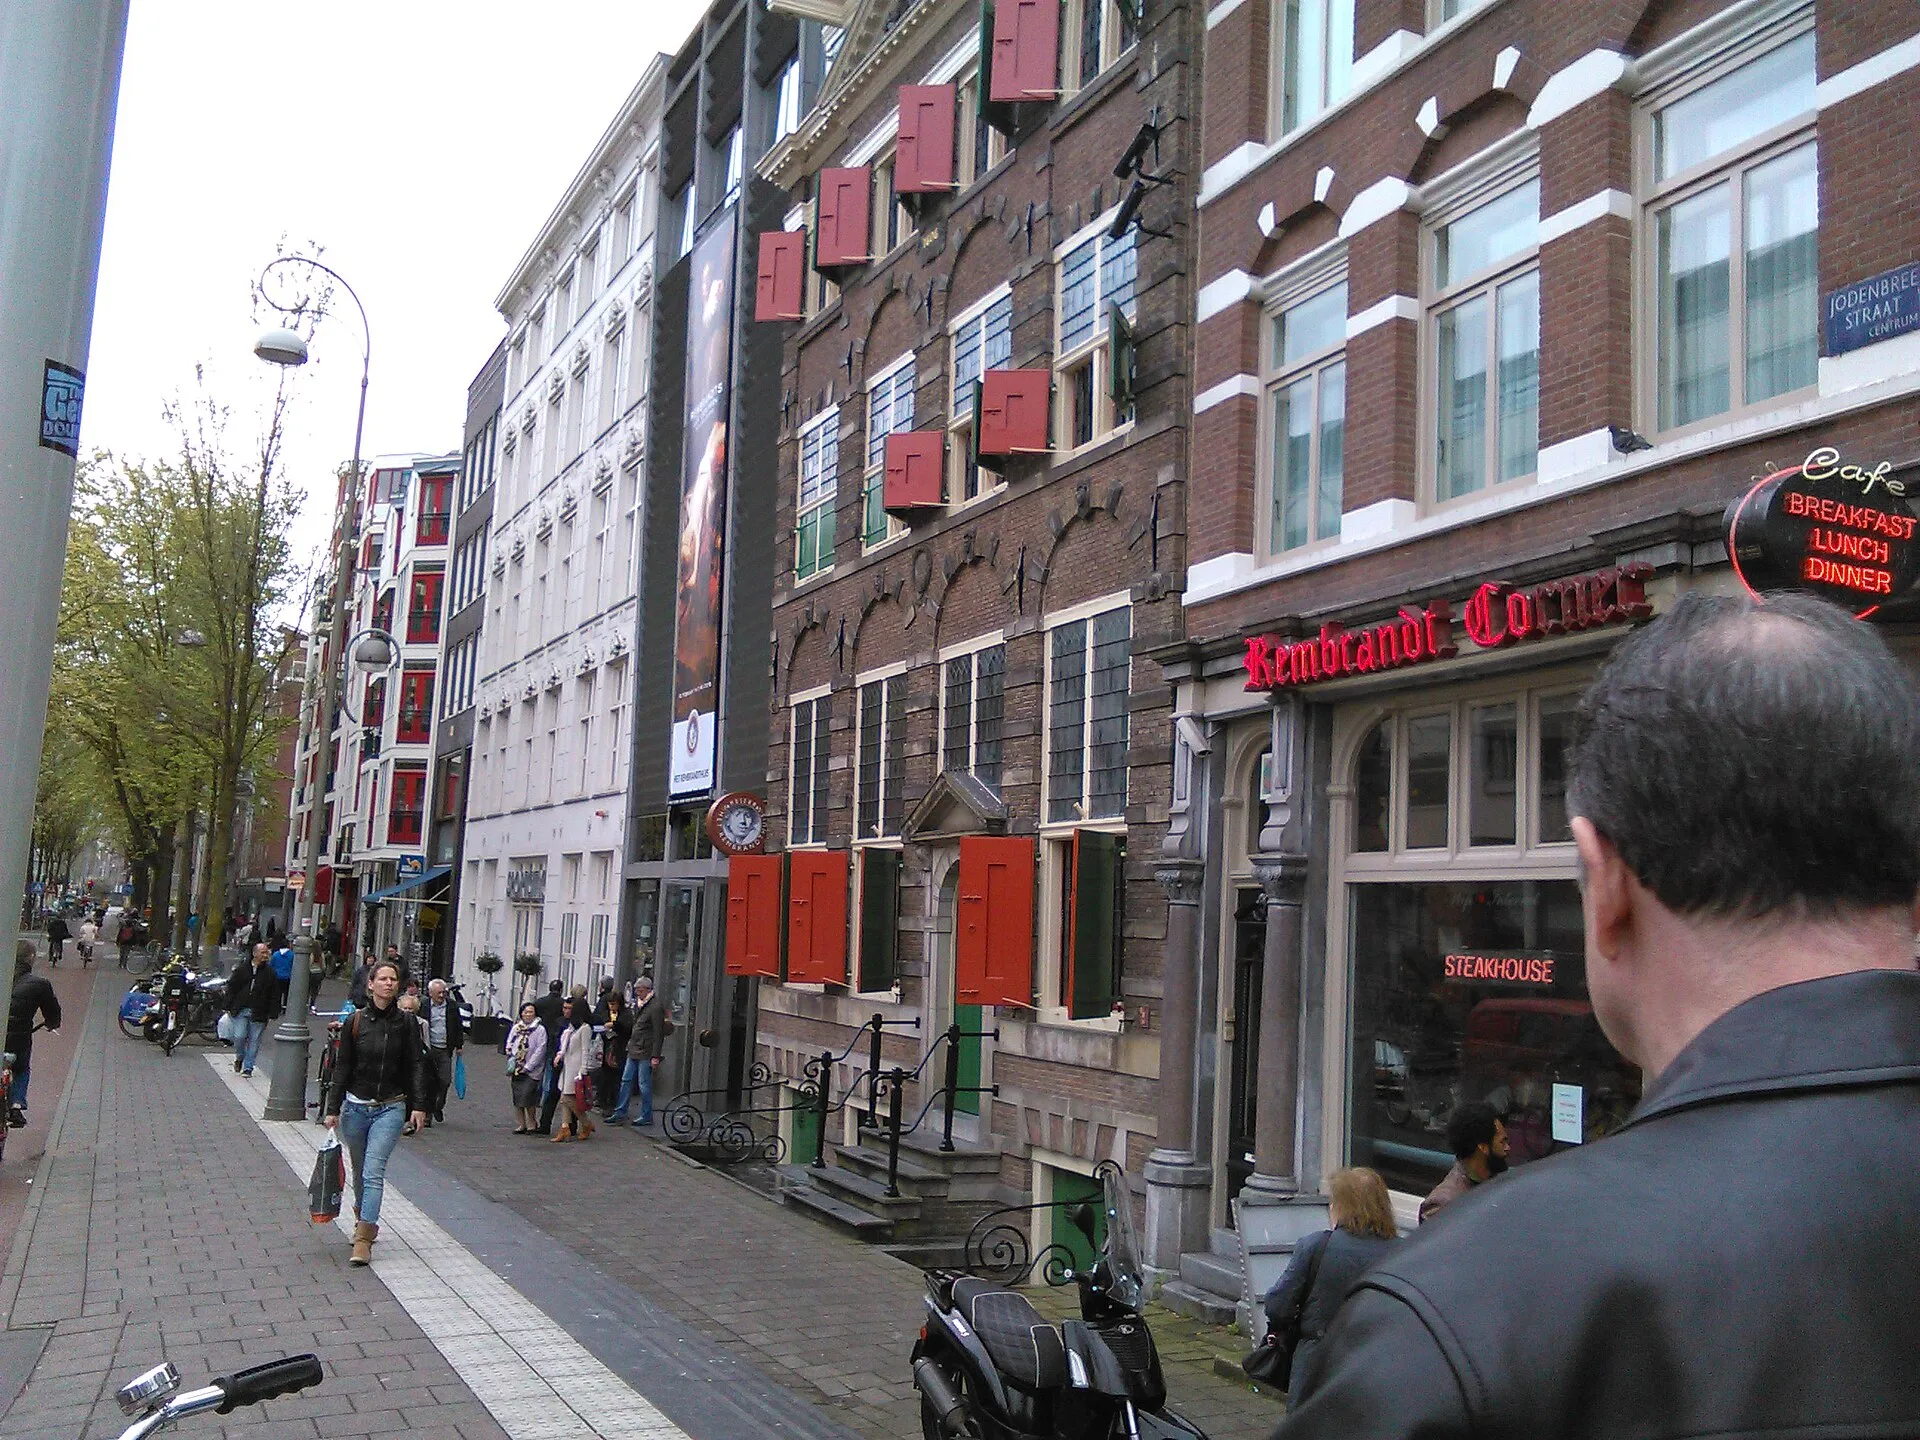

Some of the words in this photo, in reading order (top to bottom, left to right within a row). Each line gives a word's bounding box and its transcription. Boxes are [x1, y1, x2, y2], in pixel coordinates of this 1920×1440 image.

[1830, 268, 1919, 318] JODENBREE
[1845, 296, 1902, 330] STRAAT
[1869, 313, 1919, 338] CENTRUM
[45, 386, 82, 424] Ge
[43, 420, 79, 438] DOU
[1802, 447, 1906, 497] Cafe
[1787, 492, 1918, 540] BREAKFAST
[1813, 528, 1889, 564] LUNCH
[1807, 557, 1892, 594] DINNER
[1243, 600, 1459, 693] Rembrandt
[1464, 561, 1656, 648] Corner
[1444, 955, 1555, 984] STEAKHOUSE
